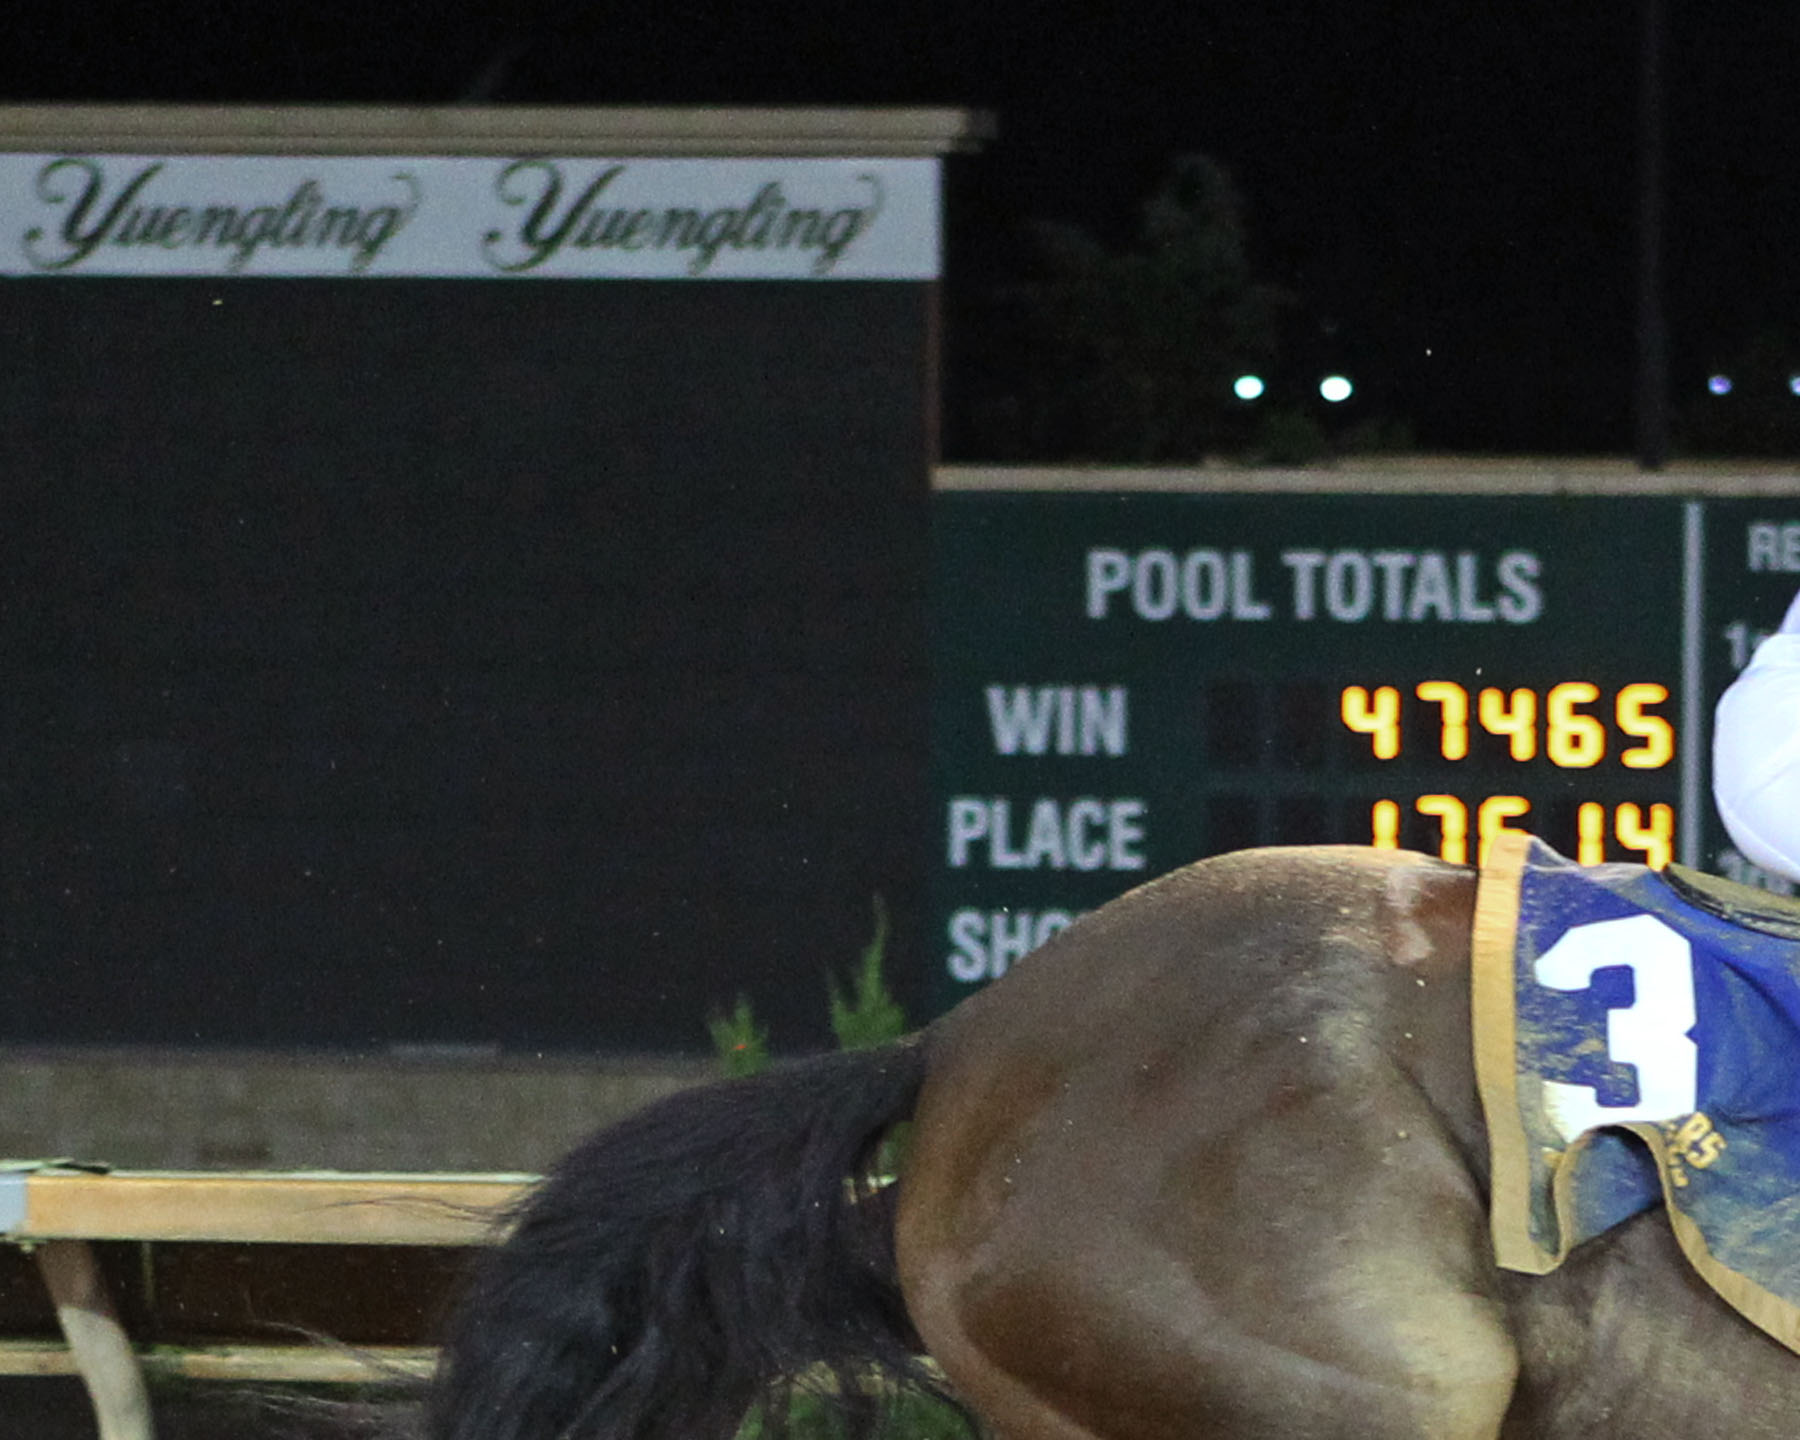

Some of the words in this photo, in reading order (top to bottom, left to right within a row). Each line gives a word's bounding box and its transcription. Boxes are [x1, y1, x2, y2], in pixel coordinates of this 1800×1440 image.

[24, 155, 422, 272] Yuengling
[482, 158, 884, 274] Yuengling
[1086, 549, 1272, 621] POOL
[1283, 549, 1545, 623] TOTALS
[985, 686, 1130, 756] WIN
[1341, 680, 1676, 768] 47465
[948, 796, 1148, 870] PLACE
[1533, 914, 1698, 1143] 3
